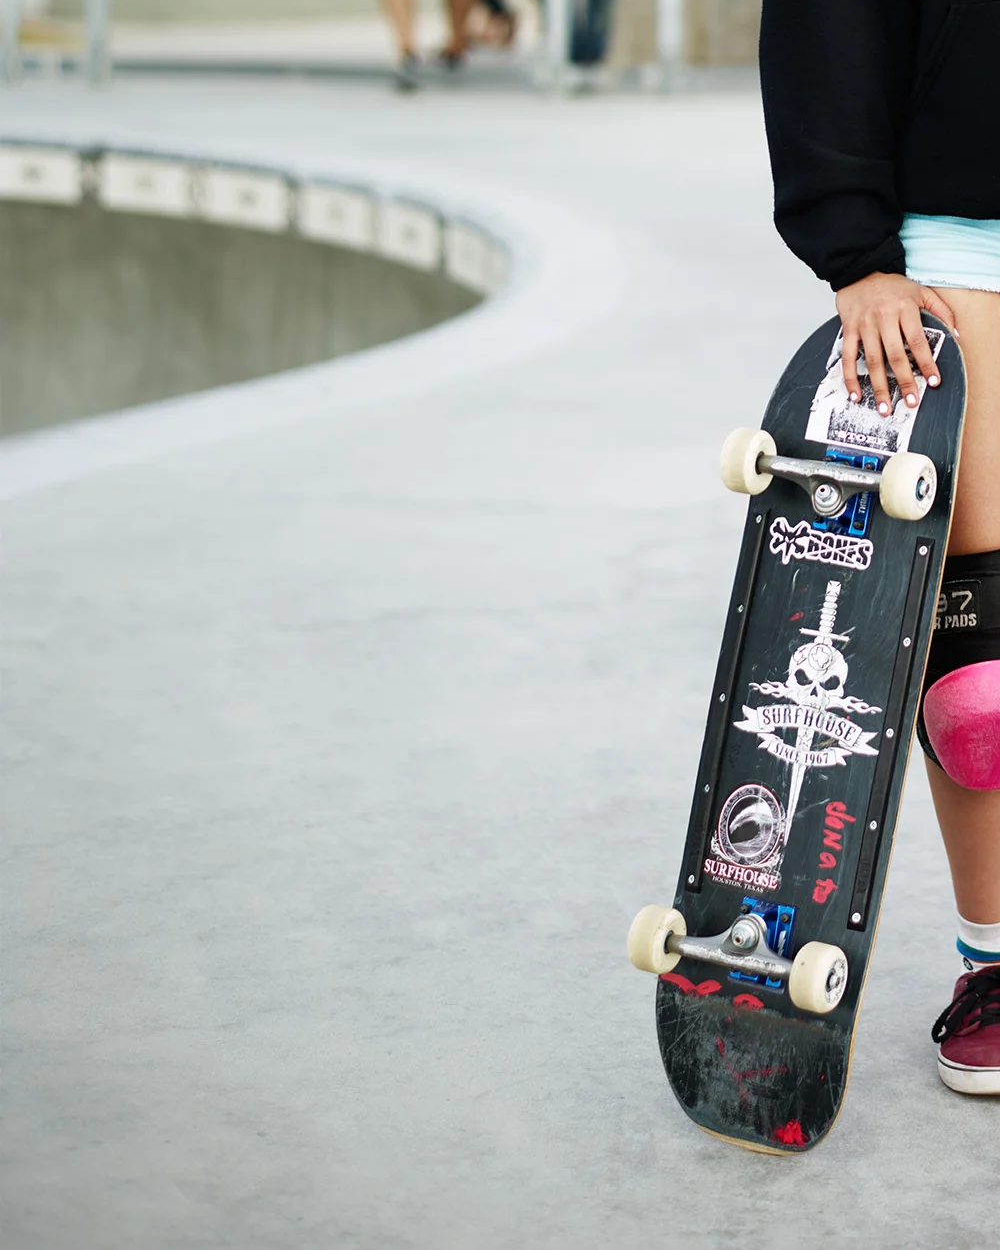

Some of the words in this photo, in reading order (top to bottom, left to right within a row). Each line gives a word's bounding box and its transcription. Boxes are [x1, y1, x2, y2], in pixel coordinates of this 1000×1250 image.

[807, 533, 871, 566] BONES
[945, 613, 977, 629] PADS
[763, 706, 857, 743] SURFHOUSE
[774, 743, 801, 762] SINCE
[804, 753, 829, 765] 1967
[704, 858, 778, 889] SURFHOUSE
